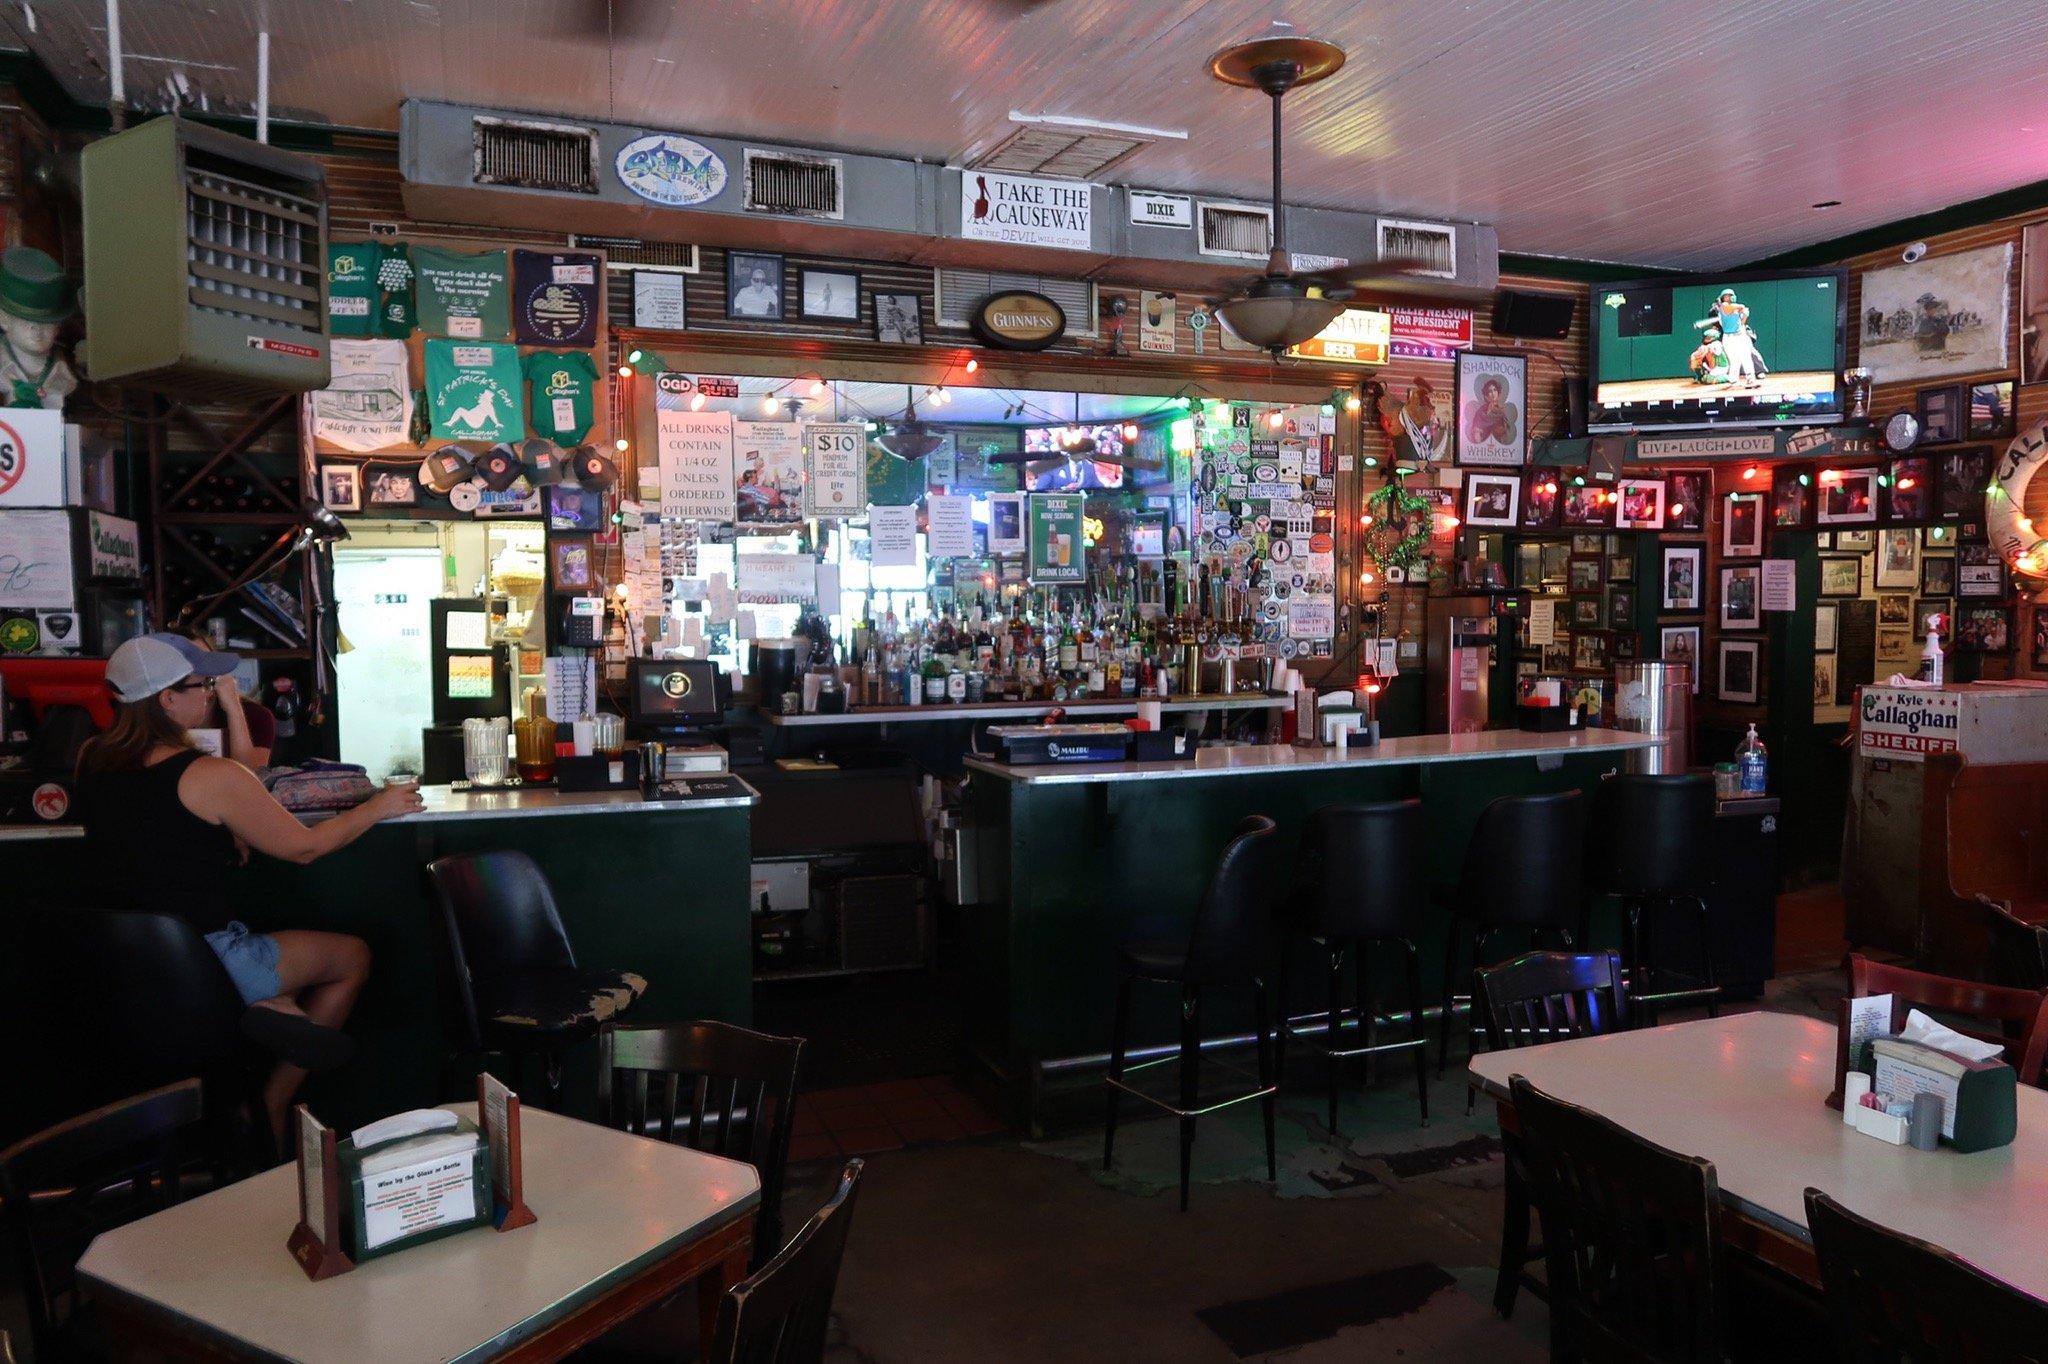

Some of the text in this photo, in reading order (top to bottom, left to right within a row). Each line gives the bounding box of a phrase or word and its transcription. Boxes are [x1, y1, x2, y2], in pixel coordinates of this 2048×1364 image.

[995, 181, 1089, 209] TAKE THE
[1146, 202, 1175, 217] DIXIE
[995, 203, 1090, 231] CAUSEWAY
[1001, 229, 1037, 243] DEVIL
[1385, 305, 1471, 321] WILLIE NELSON
[992, 312, 1054, 328] GUINNESS
[1393, 314, 1461, 330] FOR PRESIDENT
[1393, 327, 1460, 337] www.willienelson.com
[1142, 341, 1173, 351] GUINNESS
[1462, 360, 1522, 379] SHAMROCK
[445, 374, 498, 392] PATRICK'S
[496, 388, 518, 408] DAY
[660, 378, 692, 391] OGD
[660, 424, 730, 434] ALL DRINKS
[669, 440, 721, 450] CONTAIN
[818, 435, 855, 452] $10
[1642, 438, 1770, 455] LIVE LAUGH LOVE
[1467, 446, 1516, 459] WHISKEY
[685, 457, 699, 467] 1/4
[701, 457, 717, 467] OZ
[822, 462, 835, 470] FOR
[674, 473, 719, 483] UNLESS
[815, 470, 856, 478] CREDIT CARDS
[669, 489, 725, 500] ORDERED
[663, 505, 731, 516] OTHERWISE
[1046, 499, 1068, 509] DIXIE
[1036, 567, 1079, 577] DRINK LOCAL
[738, 590, 778, 604] Coors
[1896, 693, 1924, 706] Kyle
[1862, 705, 1958, 733] Callaghan
[1863, 734, 1955, 753] SHERIFF
[377, 1180, 393, 1188] Wine
[405, 1173, 415, 1181] the
[416, 1169, 434, 1178] Glass
[443, 1161, 461, 1171] Bottle
